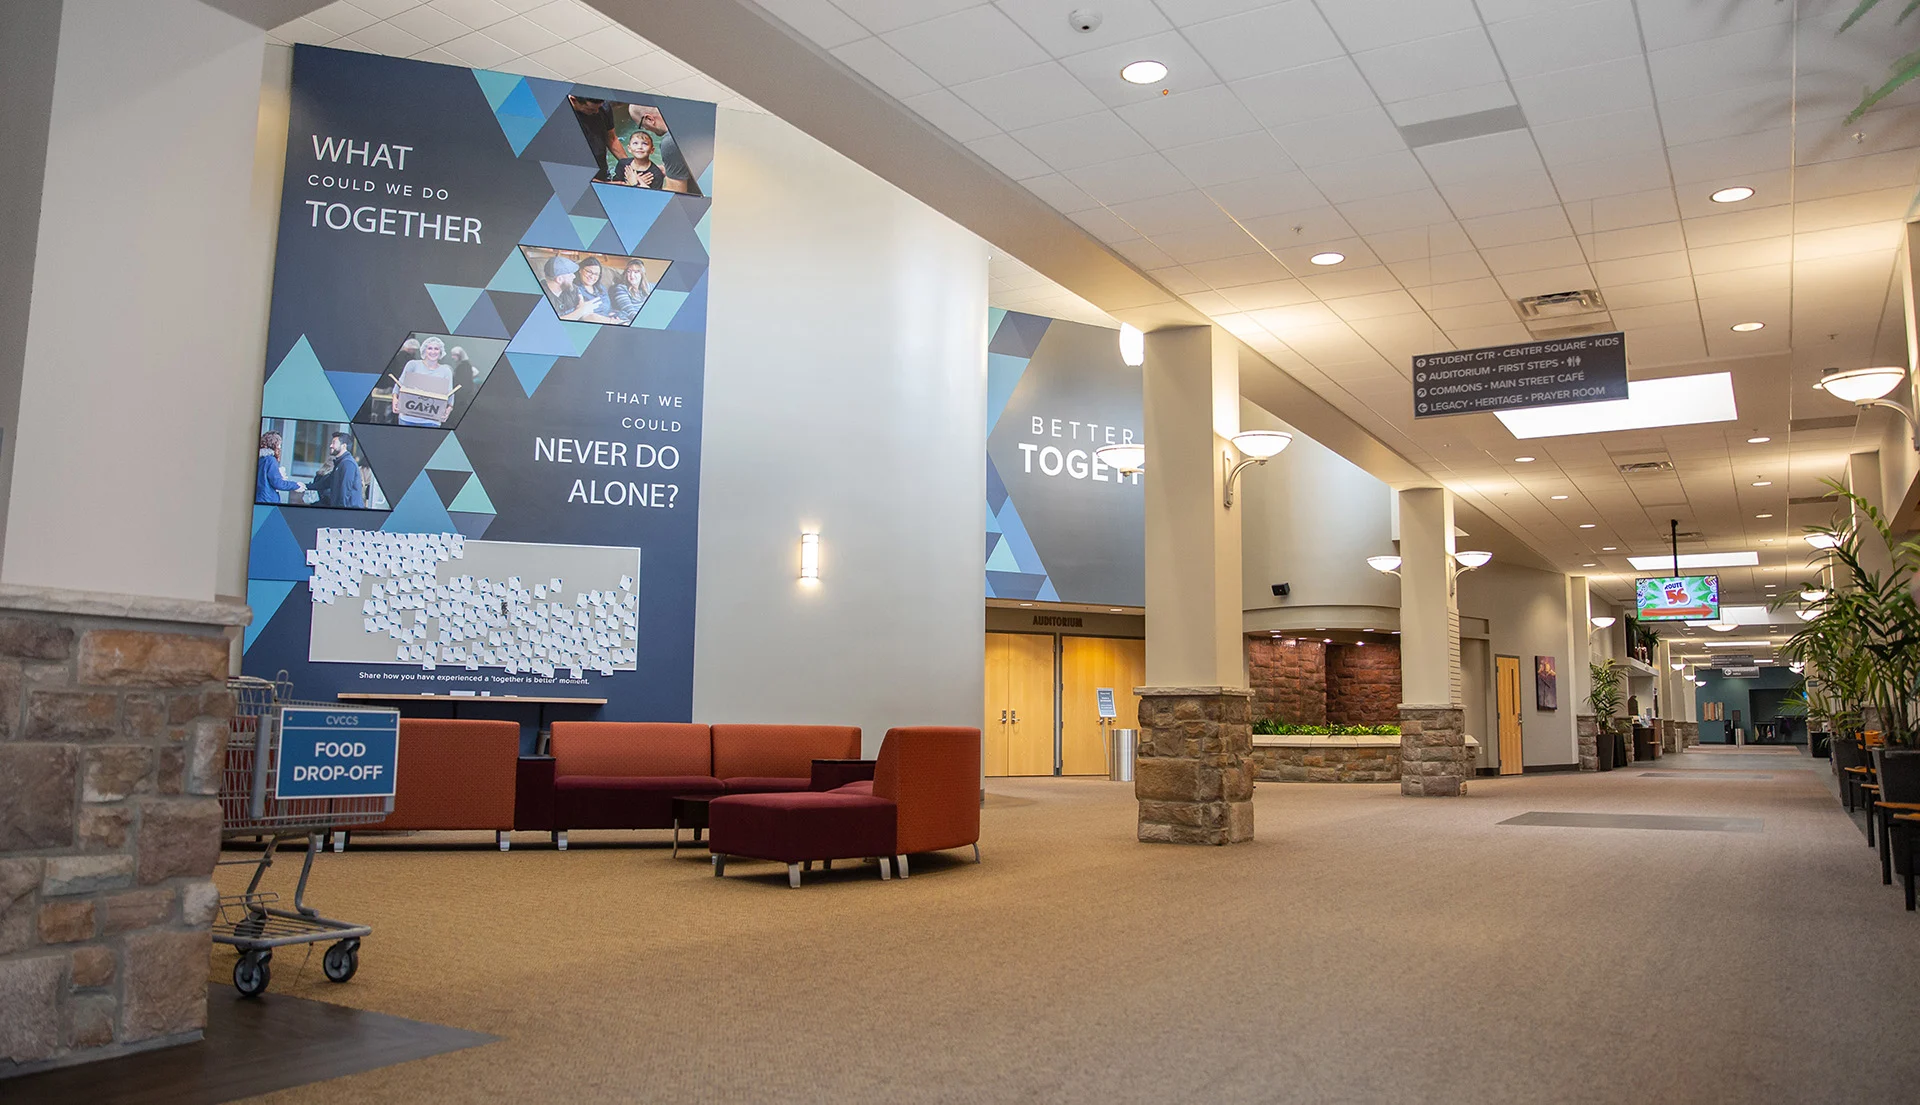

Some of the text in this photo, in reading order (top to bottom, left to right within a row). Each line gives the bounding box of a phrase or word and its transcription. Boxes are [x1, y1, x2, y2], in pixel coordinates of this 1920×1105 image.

[312, 134, 413, 171] WHAT
[307, 174, 449, 200] COULD WE DO
[305, 200, 482, 244] TOGETHER
[1428, 337, 1620, 366] STUDENT CTR CENTER SQUARE KIDS
[1428, 359, 1559, 380] AUDITORIUM FIRST STEPS
[1429, 370, 1585, 396] COMMONS MAIN STREET CAFÉ
[606, 391, 682, 408] THAT WE
[1430, 386, 1605, 412] LEGACY HERITAGE PRAYER ROOM
[622, 417, 681, 433] COULD
[1031, 415, 1134, 445] BETTER
[534, 437, 680, 470] NEVER DO
[568, 479, 679, 509] ALONE?
[1664, 581, 1683, 590] ROUTE
[1665, 588, 1689, 605] 56
[1032, 615, 1083, 628] AUDITORIUM
[359, 671, 381, 680] Share
[383, 672, 399, 680] how
[436, 674, 483, 682] experienced
[526, 675, 532, 683] is
[326, 715, 359, 726] CVCCS
[315, 742, 366, 757] FOOD
[293, 764, 383, 781] DROP-OFF
